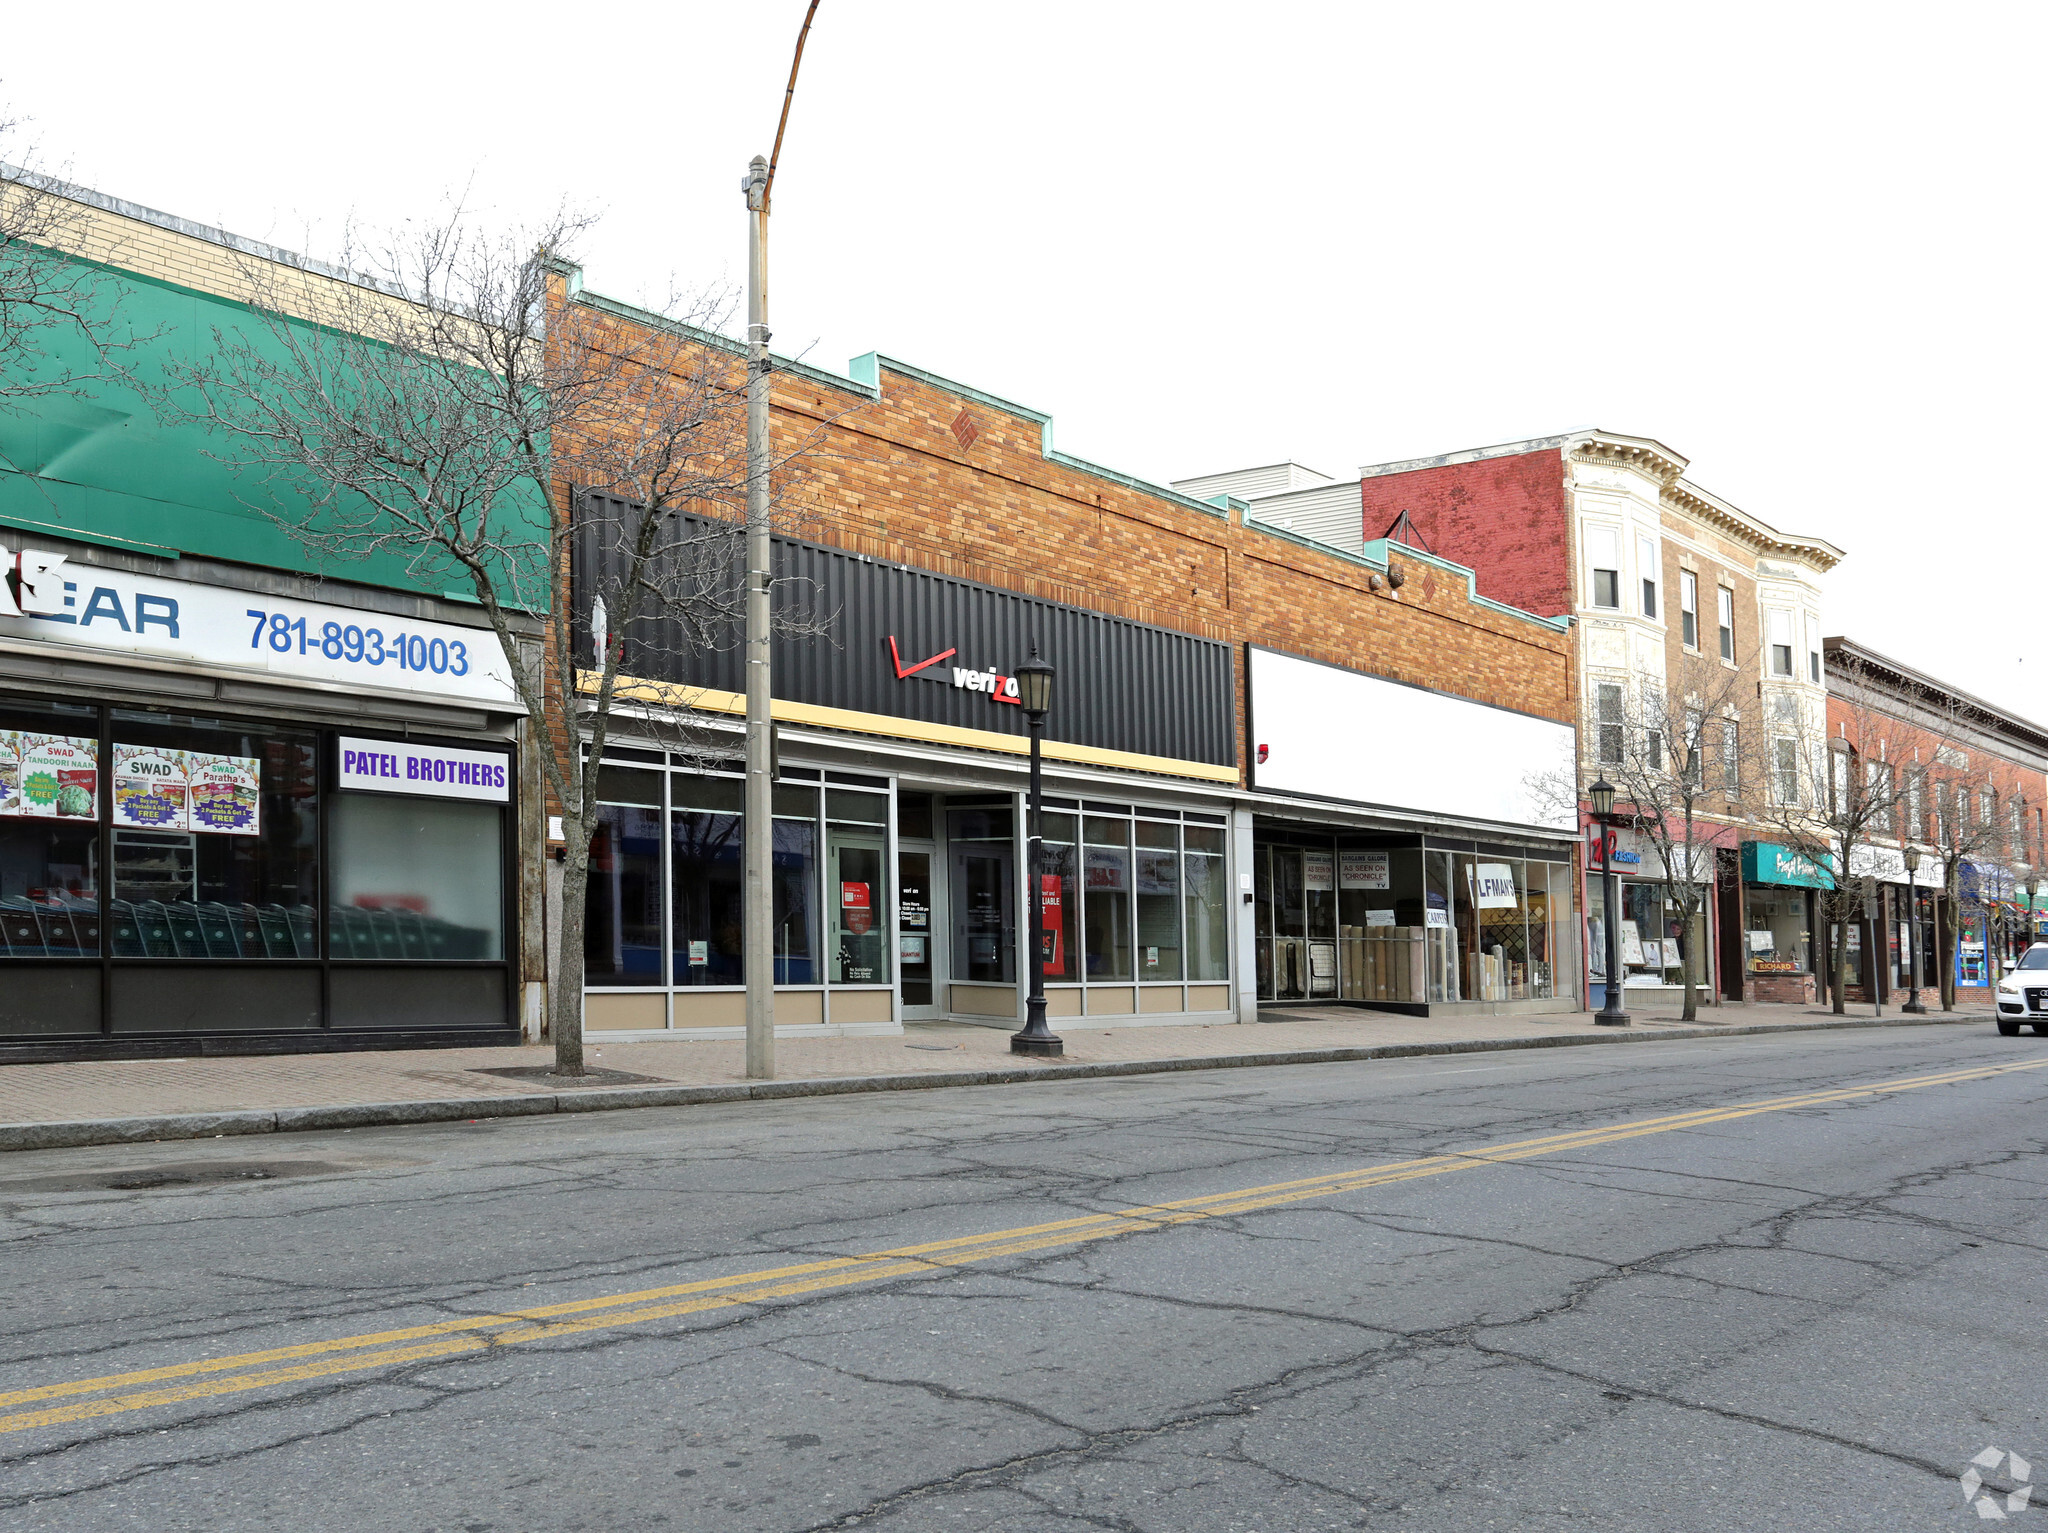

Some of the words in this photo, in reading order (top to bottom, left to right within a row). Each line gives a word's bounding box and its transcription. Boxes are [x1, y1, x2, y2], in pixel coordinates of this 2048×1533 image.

[246, 609, 469, 677] 781-893-1003
[953, 666, 1022, 704] verizo
[48, 748, 74, 757] SWAD
[28, 756, 70, 766] TANDOORI
[71, 760, 94, 768] NAAN
[131, 762, 172, 776] SWAD
[212, 765, 235, 773] SWAD
[344, 750, 400, 778] PATEL
[406, 756, 505, 788] BROTHERS
[204, 772, 246, 783] Paratha's
[30, 790, 52, 798] FREE
[1042, 897, 1060, 905] LIABLE
